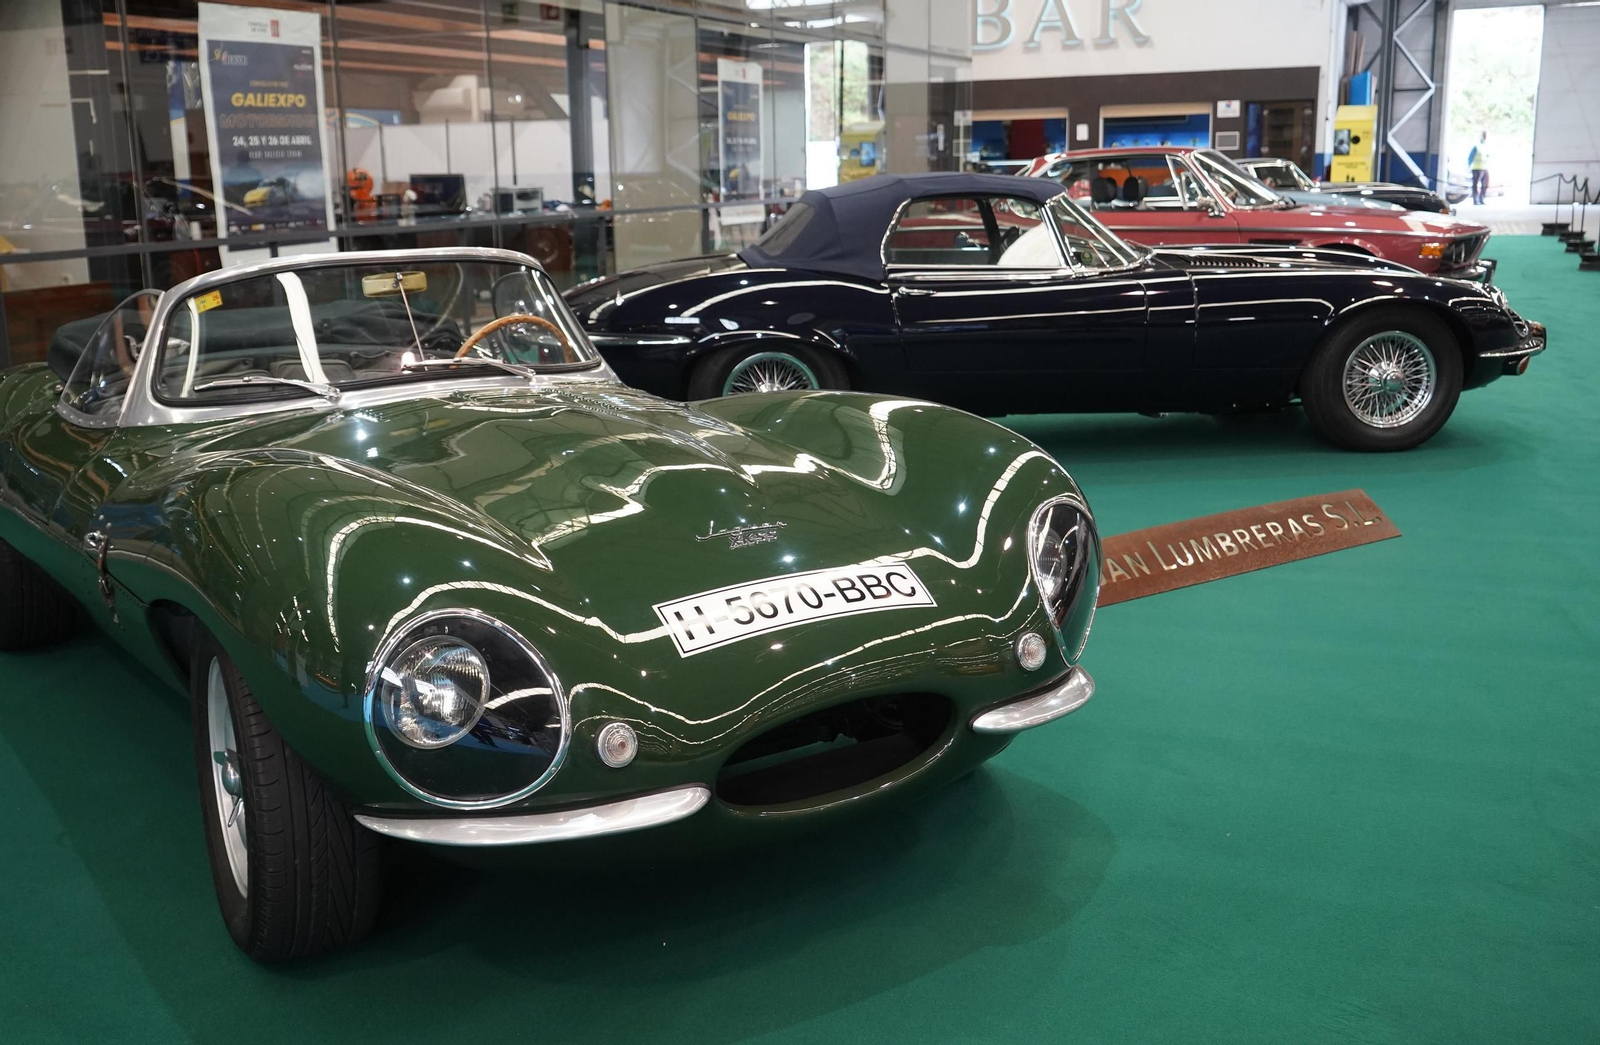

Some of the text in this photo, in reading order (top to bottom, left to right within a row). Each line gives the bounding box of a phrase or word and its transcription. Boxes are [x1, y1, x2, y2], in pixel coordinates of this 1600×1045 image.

[972, 0, 1150, 50] BAR
[231, 92, 306, 108] GALIEXPO
[248, 135, 259, 147] 25
[260, 135, 267, 146] Y
[268, 135, 278, 146] 26
[279, 135, 289, 146] DE
[290, 135, 313, 146] ABRIL
[1100, 500, 1383, 586] AN LUMBRERAS S.L.
[673, 571, 917, 641] H-5670-BBC
